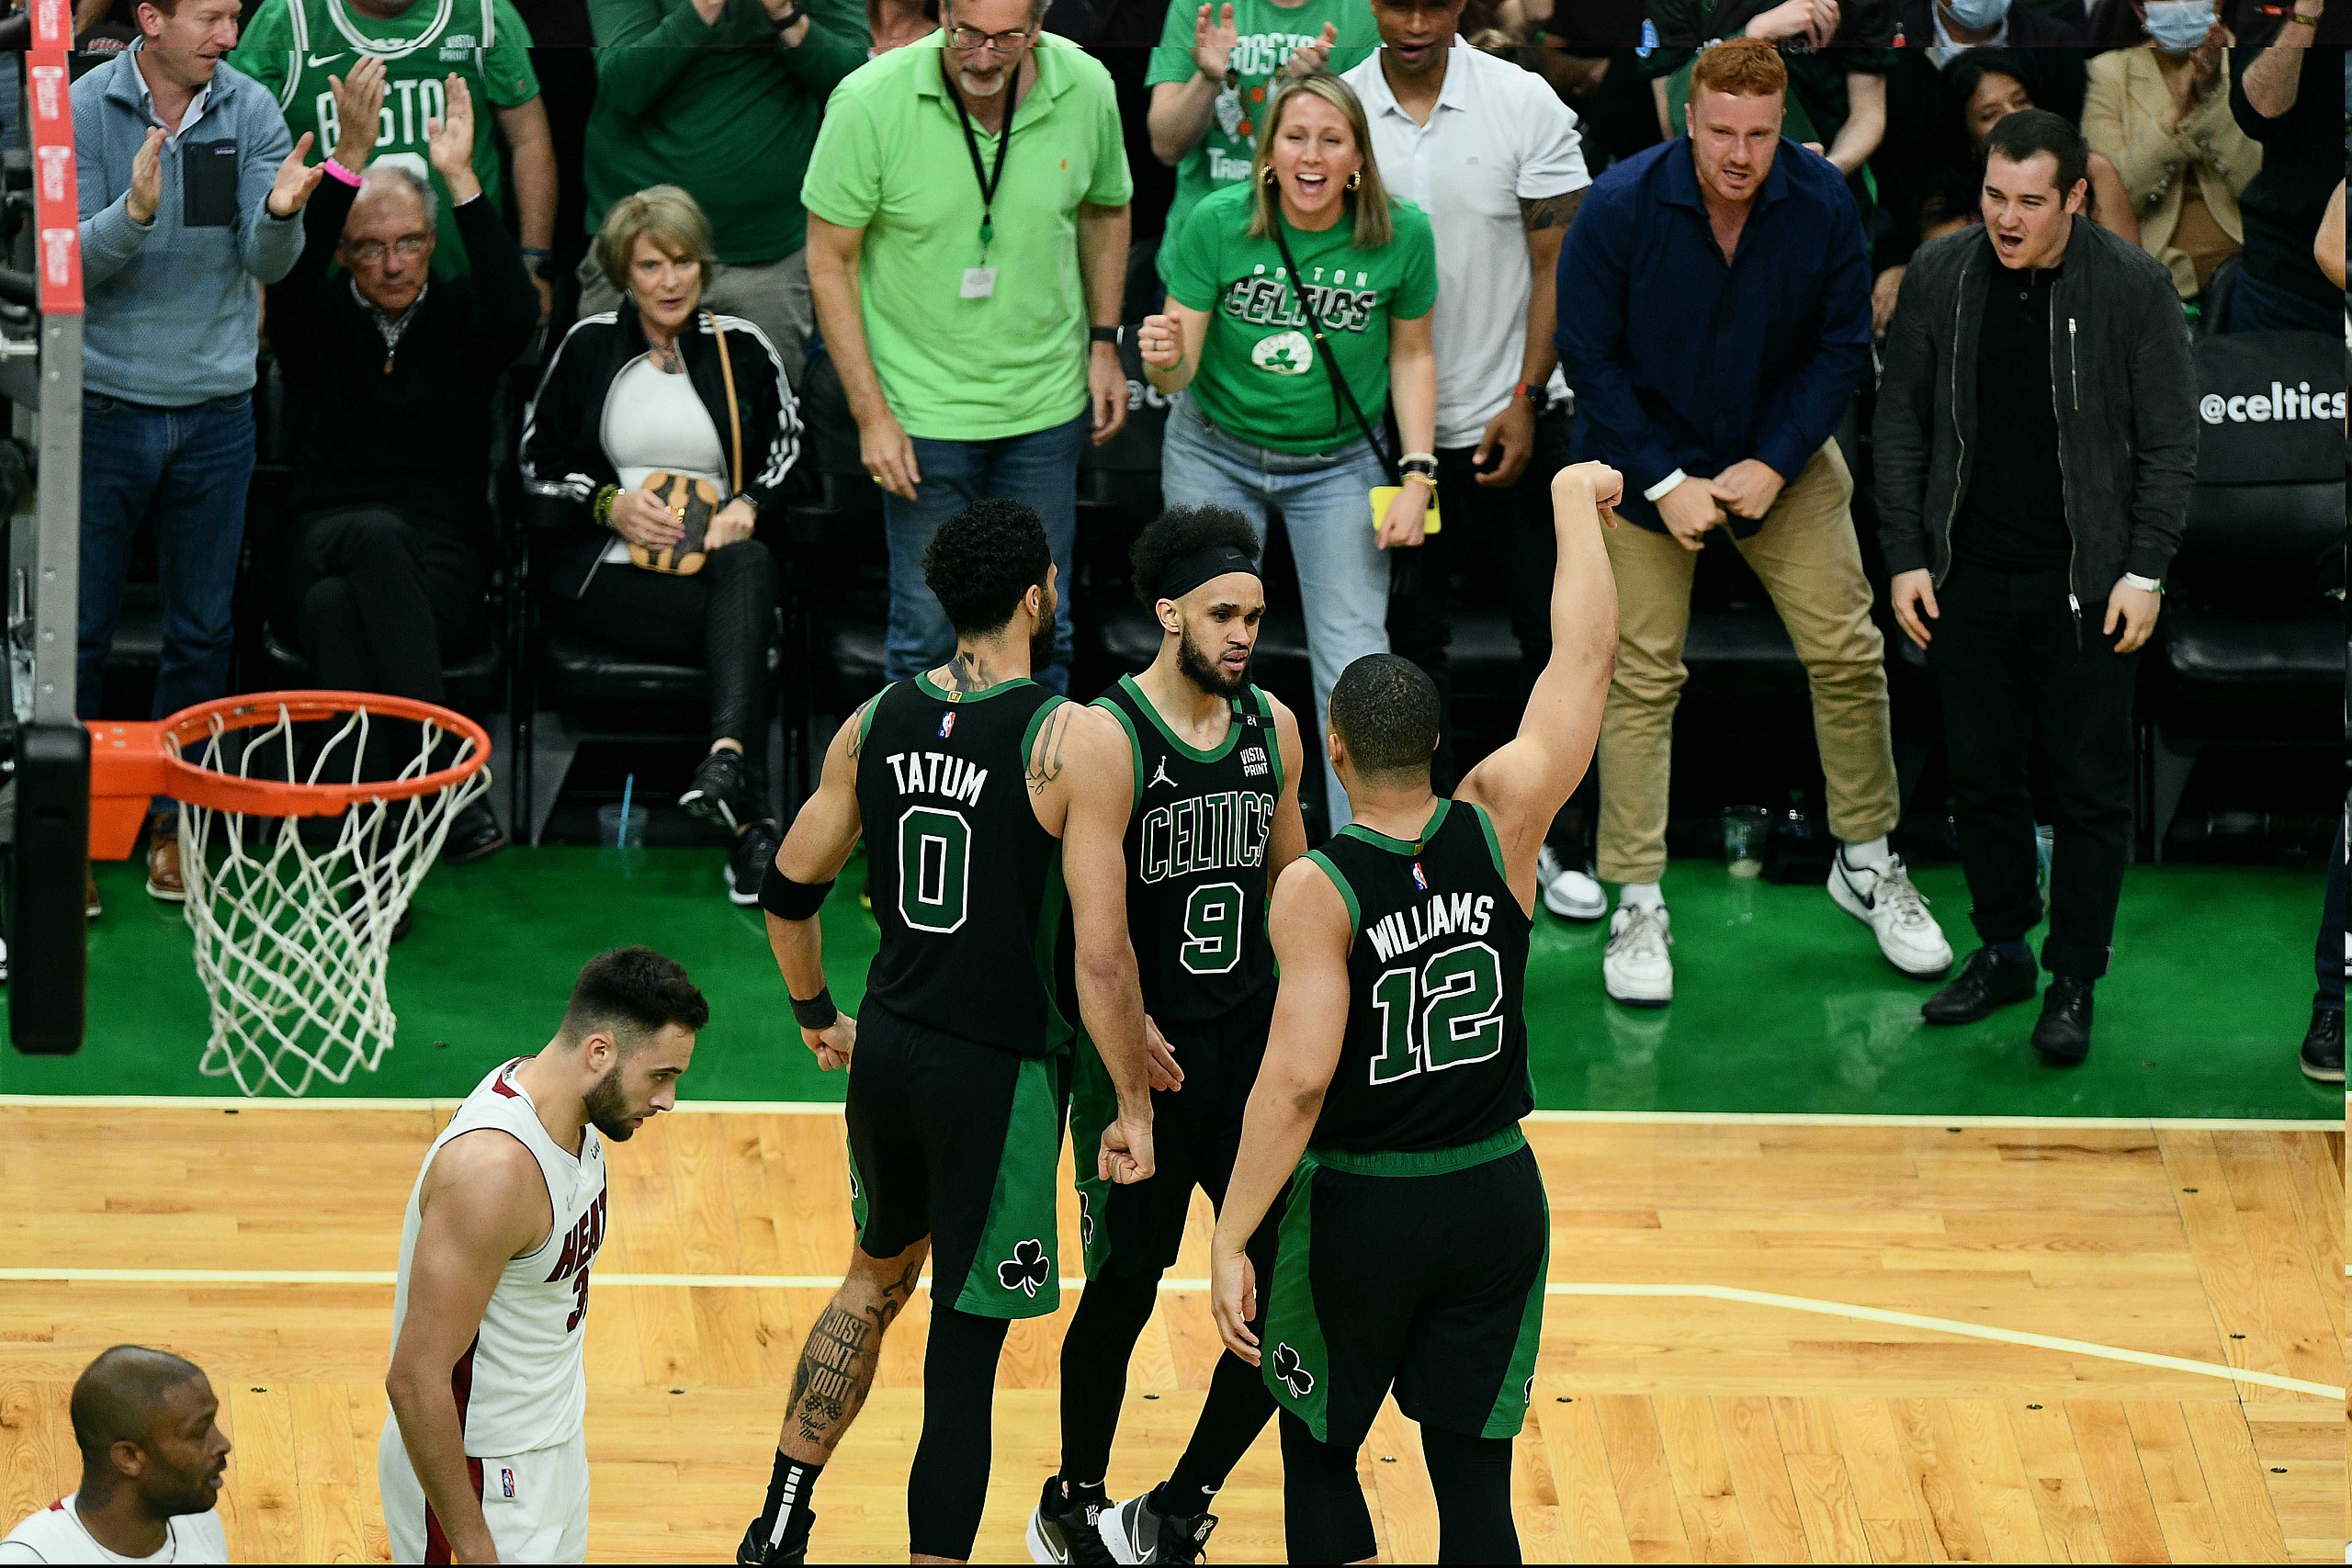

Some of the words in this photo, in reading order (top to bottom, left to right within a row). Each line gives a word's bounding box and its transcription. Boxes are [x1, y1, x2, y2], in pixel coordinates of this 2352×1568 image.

[1253, 264, 1368, 288] BOTON
[2199, 380, 2346, 424] @celtics
[1247, 716, 1258, 727] 24
[886, 751, 989, 807] TATUM
[1239, 747, 1267, 765] VISTA
[1243, 761, 1269, 778] PRINT
[1140, 790, 1274, 884] CELTICS
[898, 805, 972, 934] 0
[1180, 882, 1244, 975] 9
[1365, 892, 1494, 964] WILLIAMS
[1369, 941, 1504, 1086] 12
[566, 1264, 590, 1334] 3
[823, 1311, 870, 1348] JUST
[811, 1366, 854, 1403] QUIT
